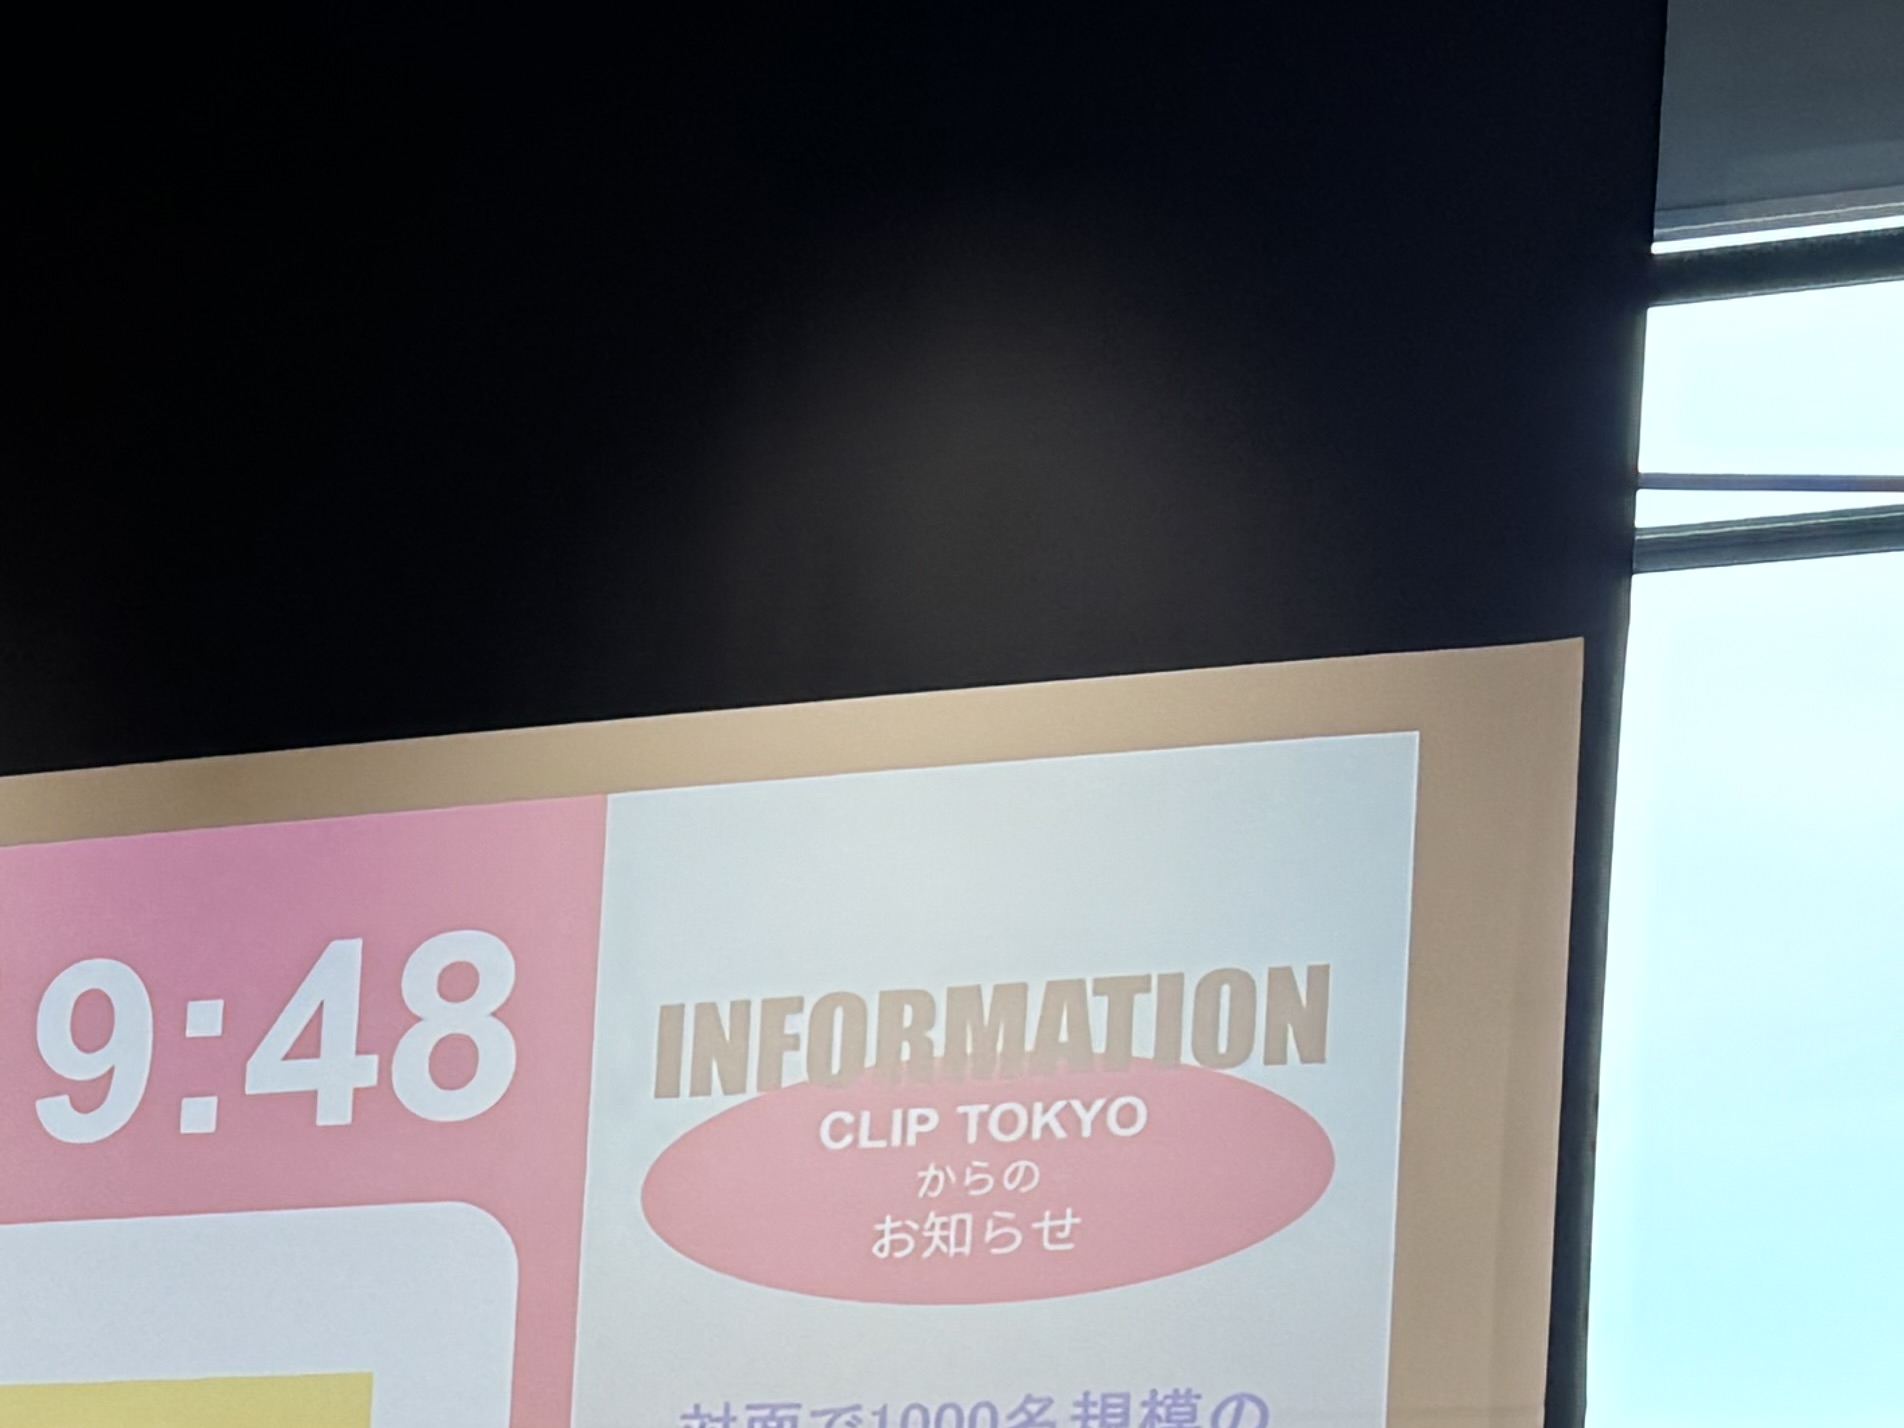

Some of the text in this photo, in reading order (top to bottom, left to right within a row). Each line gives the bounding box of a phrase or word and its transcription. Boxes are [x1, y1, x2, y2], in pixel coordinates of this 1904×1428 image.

[653, 963, 1333, 1100] INFORMATION
[818, 1095, 1150, 1152] CLIP TOKYO
[916, 1158, 1041, 1199] からの
[870, 1206, 1083, 1260] お知らせ
